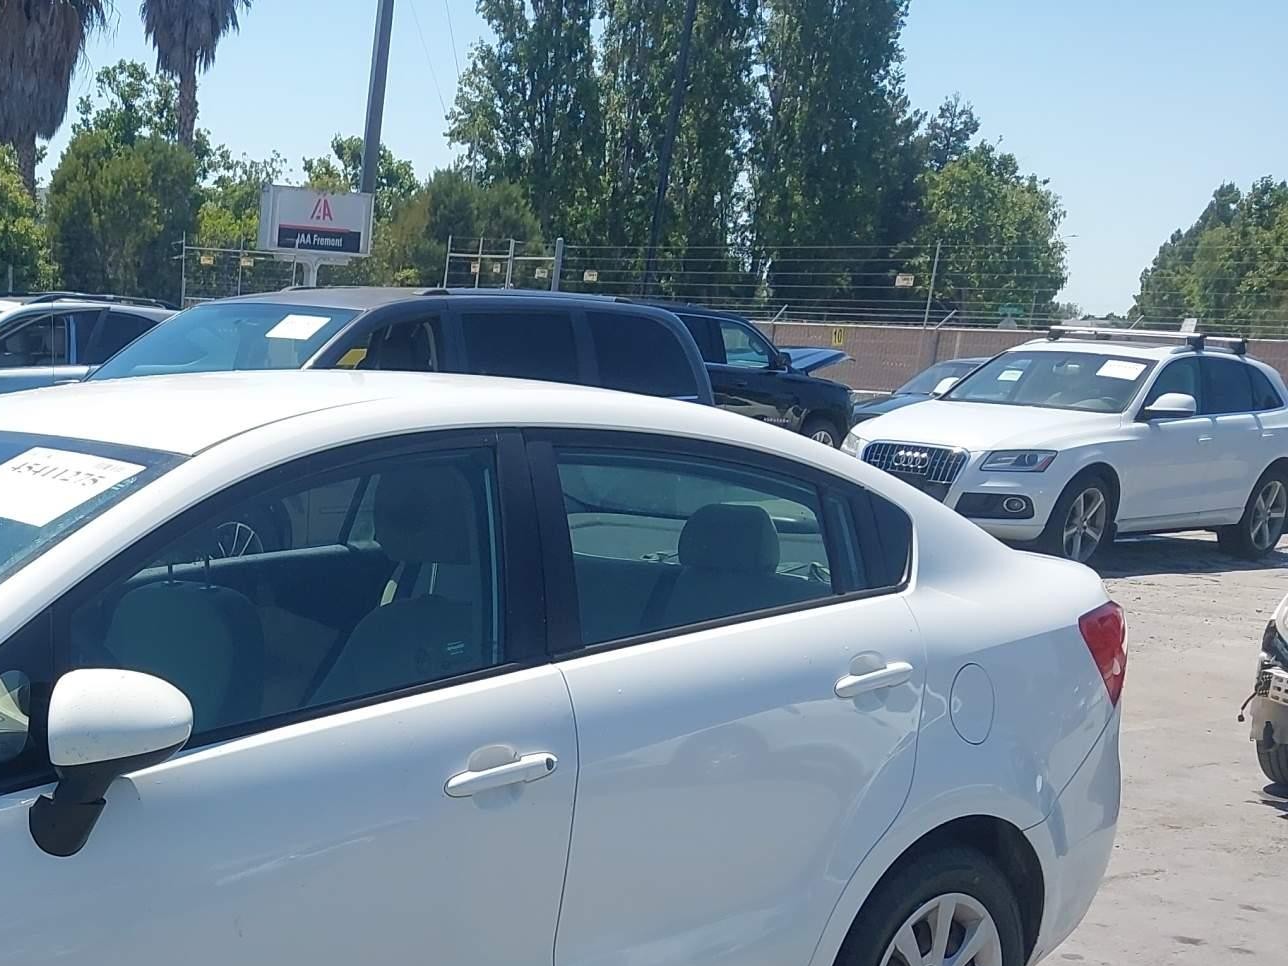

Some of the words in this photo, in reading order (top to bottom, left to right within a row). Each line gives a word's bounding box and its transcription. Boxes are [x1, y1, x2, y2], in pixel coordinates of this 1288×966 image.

[313, 234, 343, 247] Fremont
[833, 328, 843, 344] 10
[10, 462, 107, 487] 45411275
